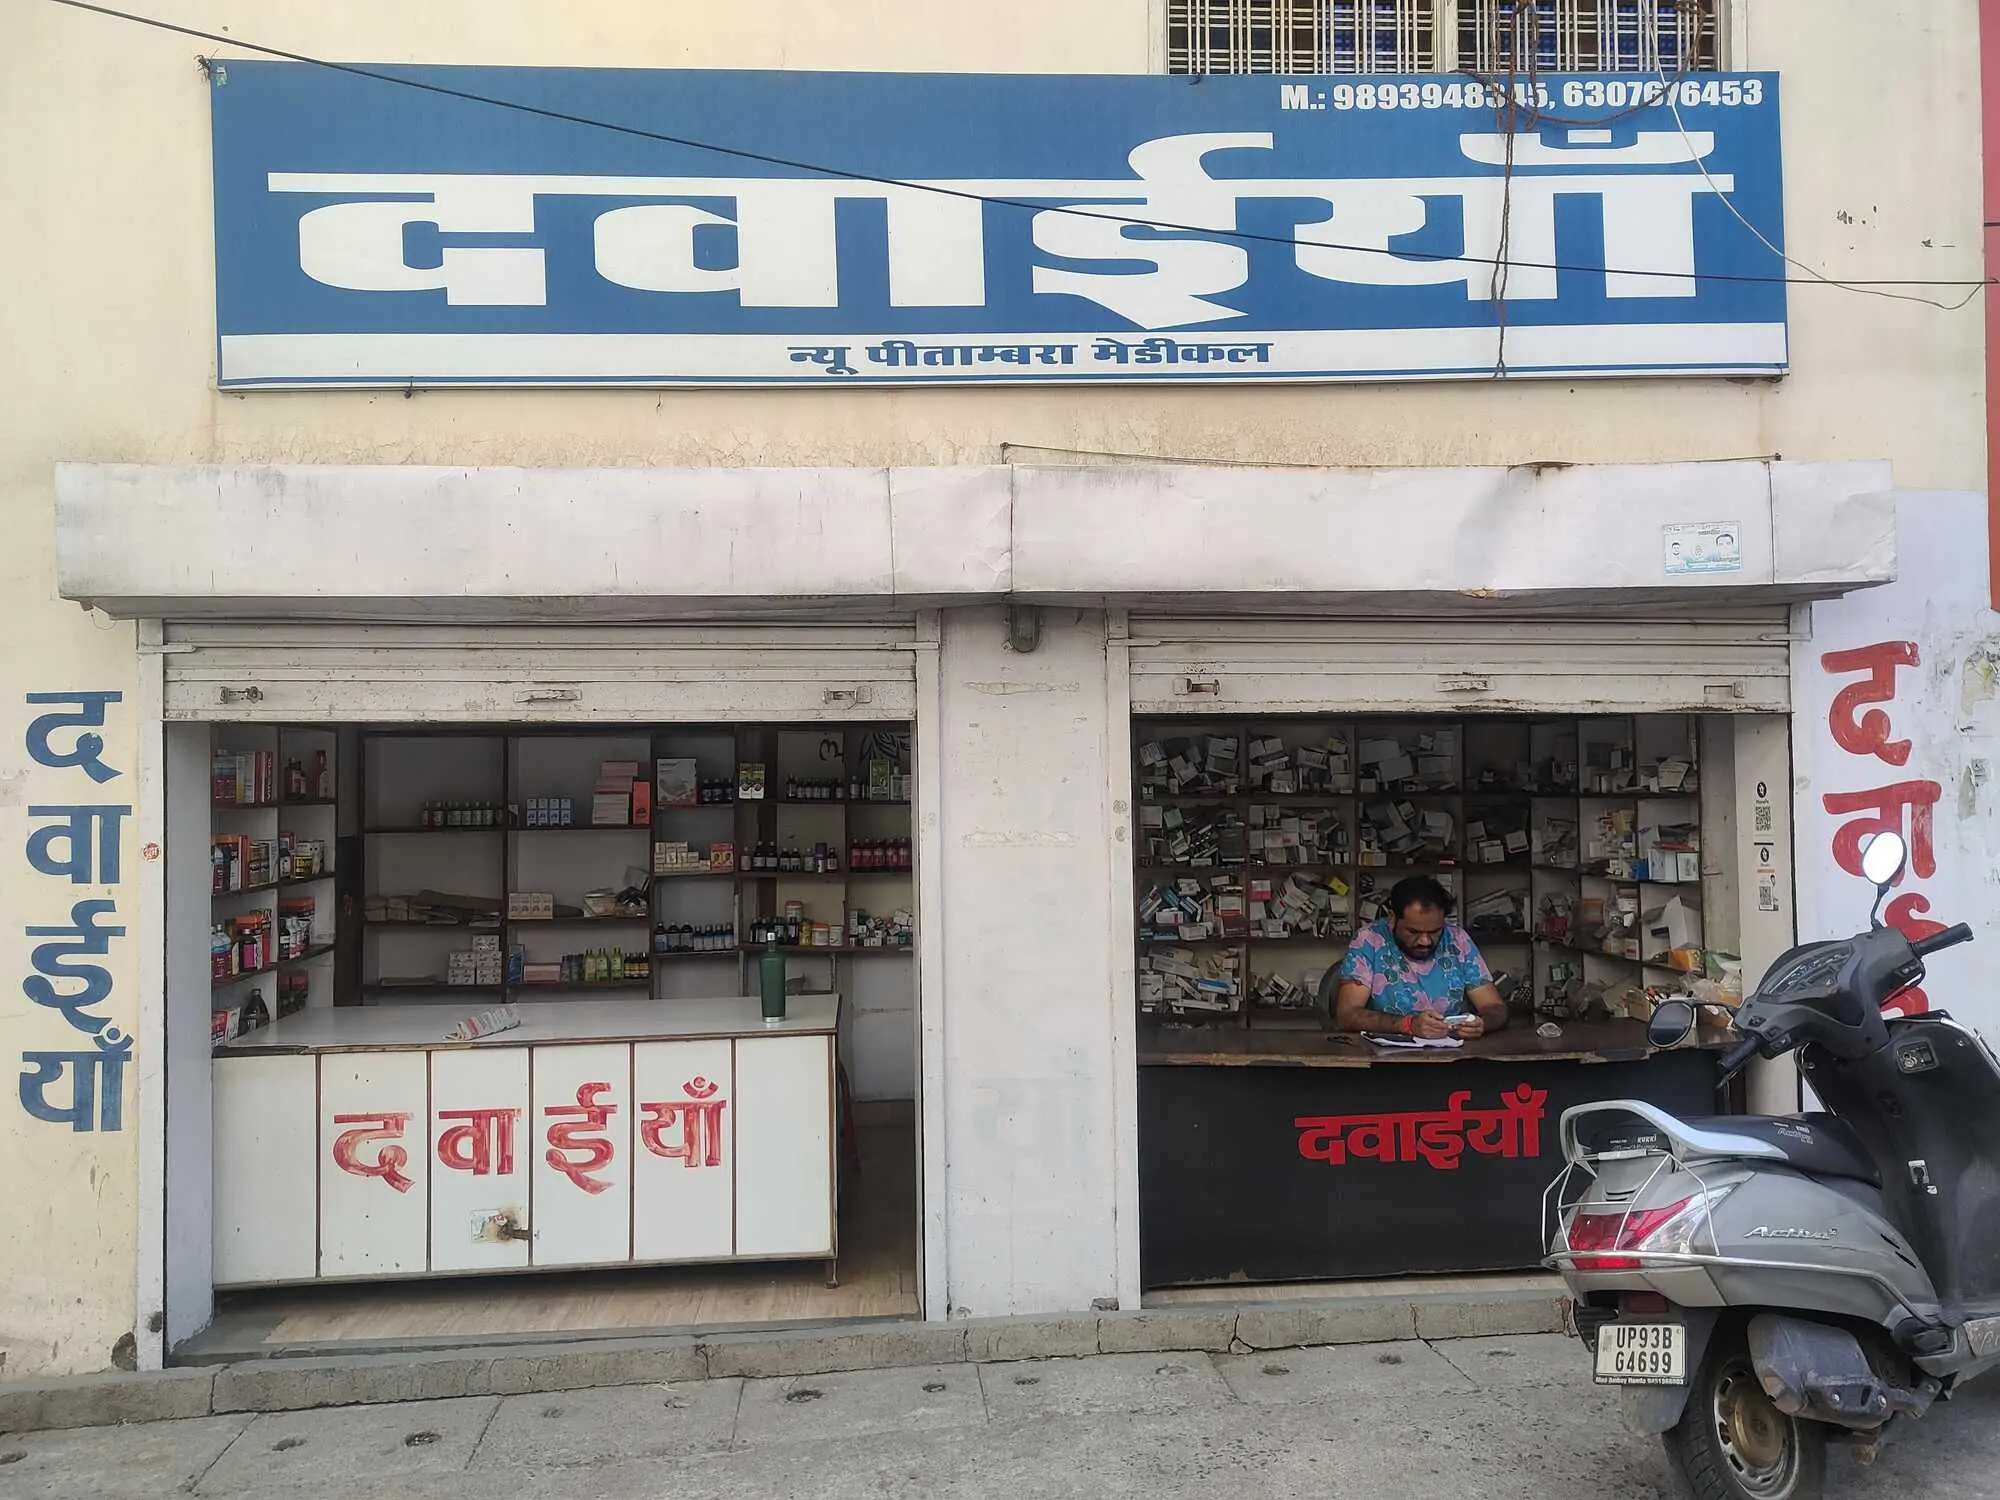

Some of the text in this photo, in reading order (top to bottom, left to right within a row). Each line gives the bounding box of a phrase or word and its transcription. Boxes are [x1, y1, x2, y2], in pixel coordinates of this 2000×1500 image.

[1563, 79, 1763, 108] 6307676453
[267, 131, 1735, 330] दवाईयाँ
[787, 337, 1274, 375] न्यू पीताम्बरा मेडीकल
[1294, 1082, 1548, 1170] दवाईयाँ
[1616, 1327, 1672, 1349] UP93B
[1615, 1351, 1672, 1374] G4699
